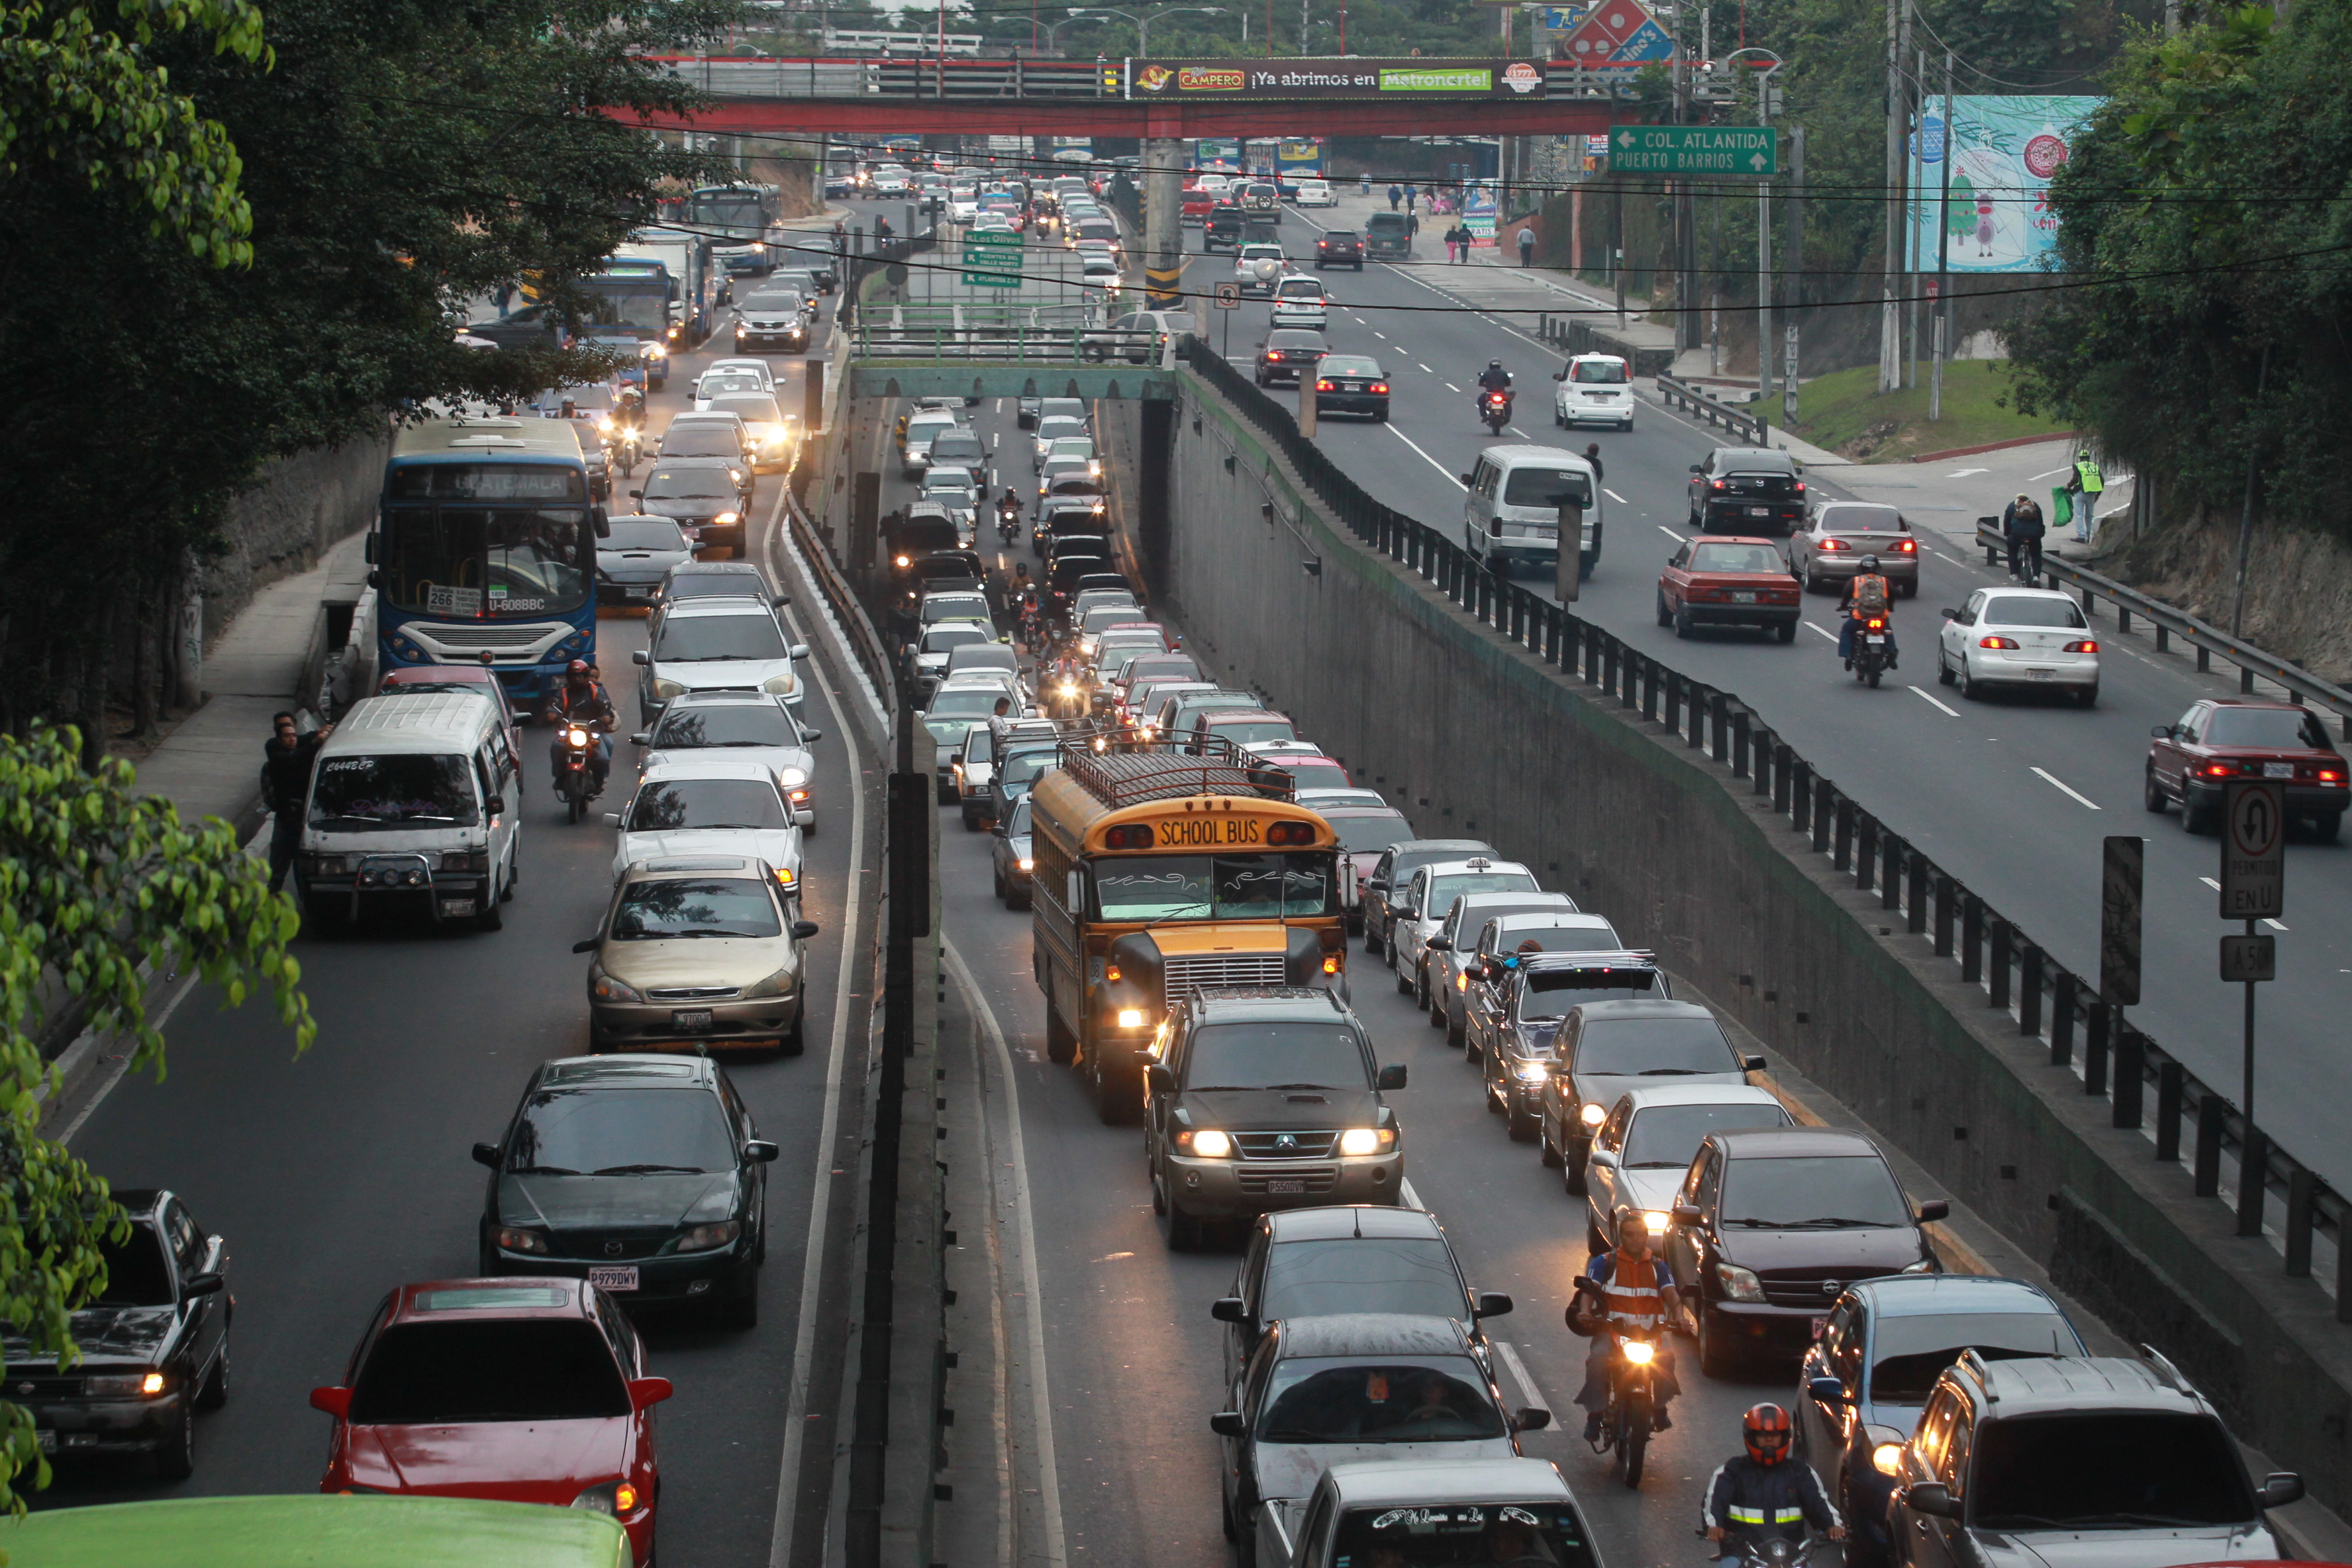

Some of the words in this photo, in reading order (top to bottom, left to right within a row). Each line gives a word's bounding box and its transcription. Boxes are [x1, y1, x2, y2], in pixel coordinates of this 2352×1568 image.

[1181, 75, 1242, 86] CAMPERO
[1251, 72, 1277, 89] ¡Ya
[1281, 71, 1349, 86] abrimos
[1354, 75, 1375, 85] en
[1645, 132, 1679, 148] COL.
[1683, 133, 1769, 149] ATLANTIDA
[1616, 152, 1668, 168] PUERTO
[1678, 153, 1734, 169] BARRIOS
[974, 234, 991, 243] Los
[993, 234, 1021, 244] Olivos
[1926, 287, 1938, 296] ALTO
[430, 593, 453, 606] 266
[489, 598, 545, 611] U-608BBC
[326, 760, 375, 772] C644BCP
[1161, 820, 1222, 845] SCHOOL
[1226, 820, 1259, 843] BUS
[2235, 890, 2257, 910] EN
[2261, 885, 2272, 909] U
[2233, 945, 2243, 971] A
[591, 1272, 636, 1285] P979DWY
